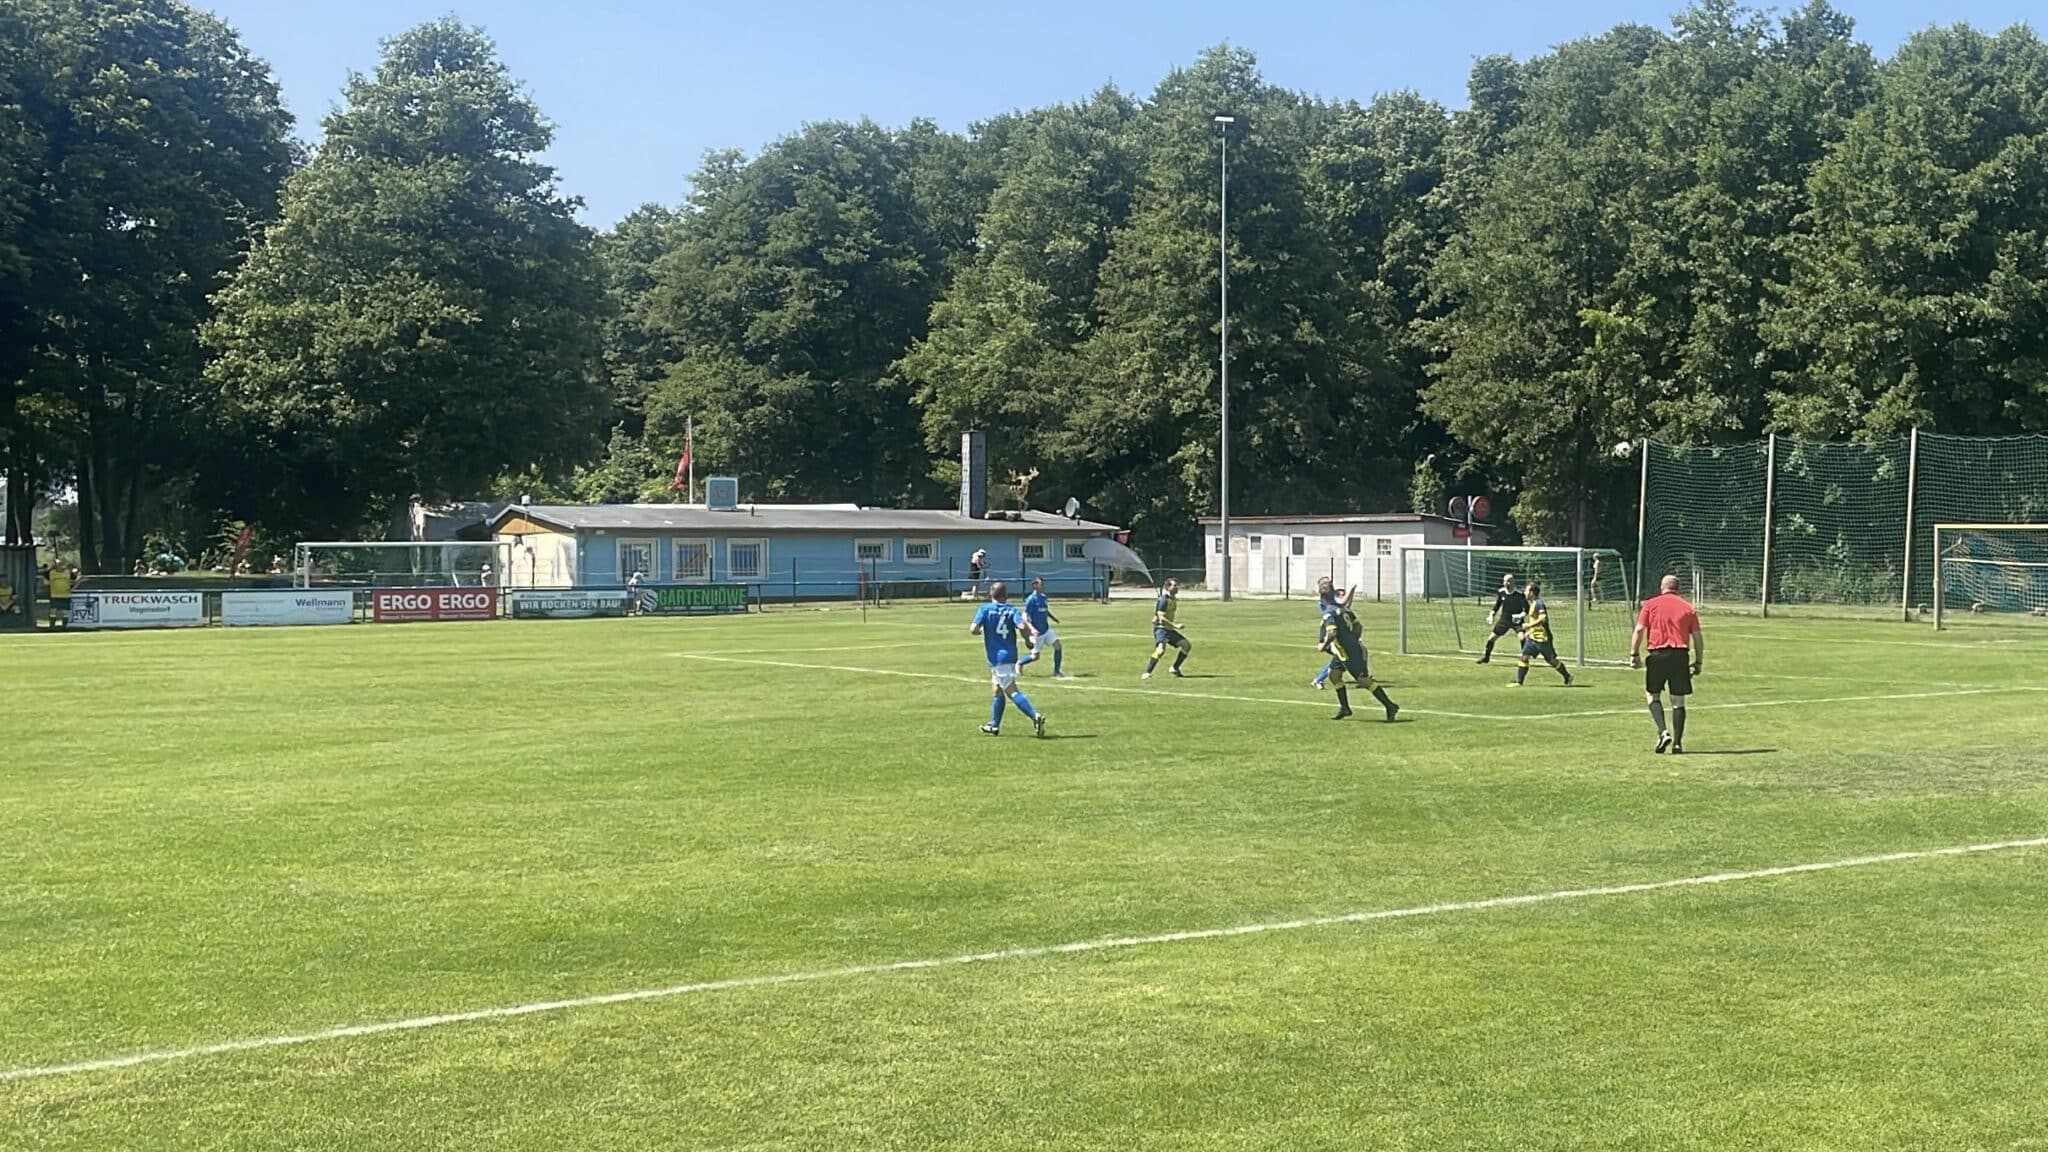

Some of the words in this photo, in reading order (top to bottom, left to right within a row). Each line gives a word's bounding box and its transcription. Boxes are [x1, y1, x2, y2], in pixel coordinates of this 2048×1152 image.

[102, 595, 198, 604] TRUCKWASCH
[295, 598, 346, 607] Wellmann
[380, 594, 432, 610] ERGO
[439, 593, 490, 609] ERGO
[520, 600, 540, 610] WIR
[541, 600, 579, 610] ROCKEN
[580, 599, 598, 609] DEN
[996, 615, 1009, 639] 4
